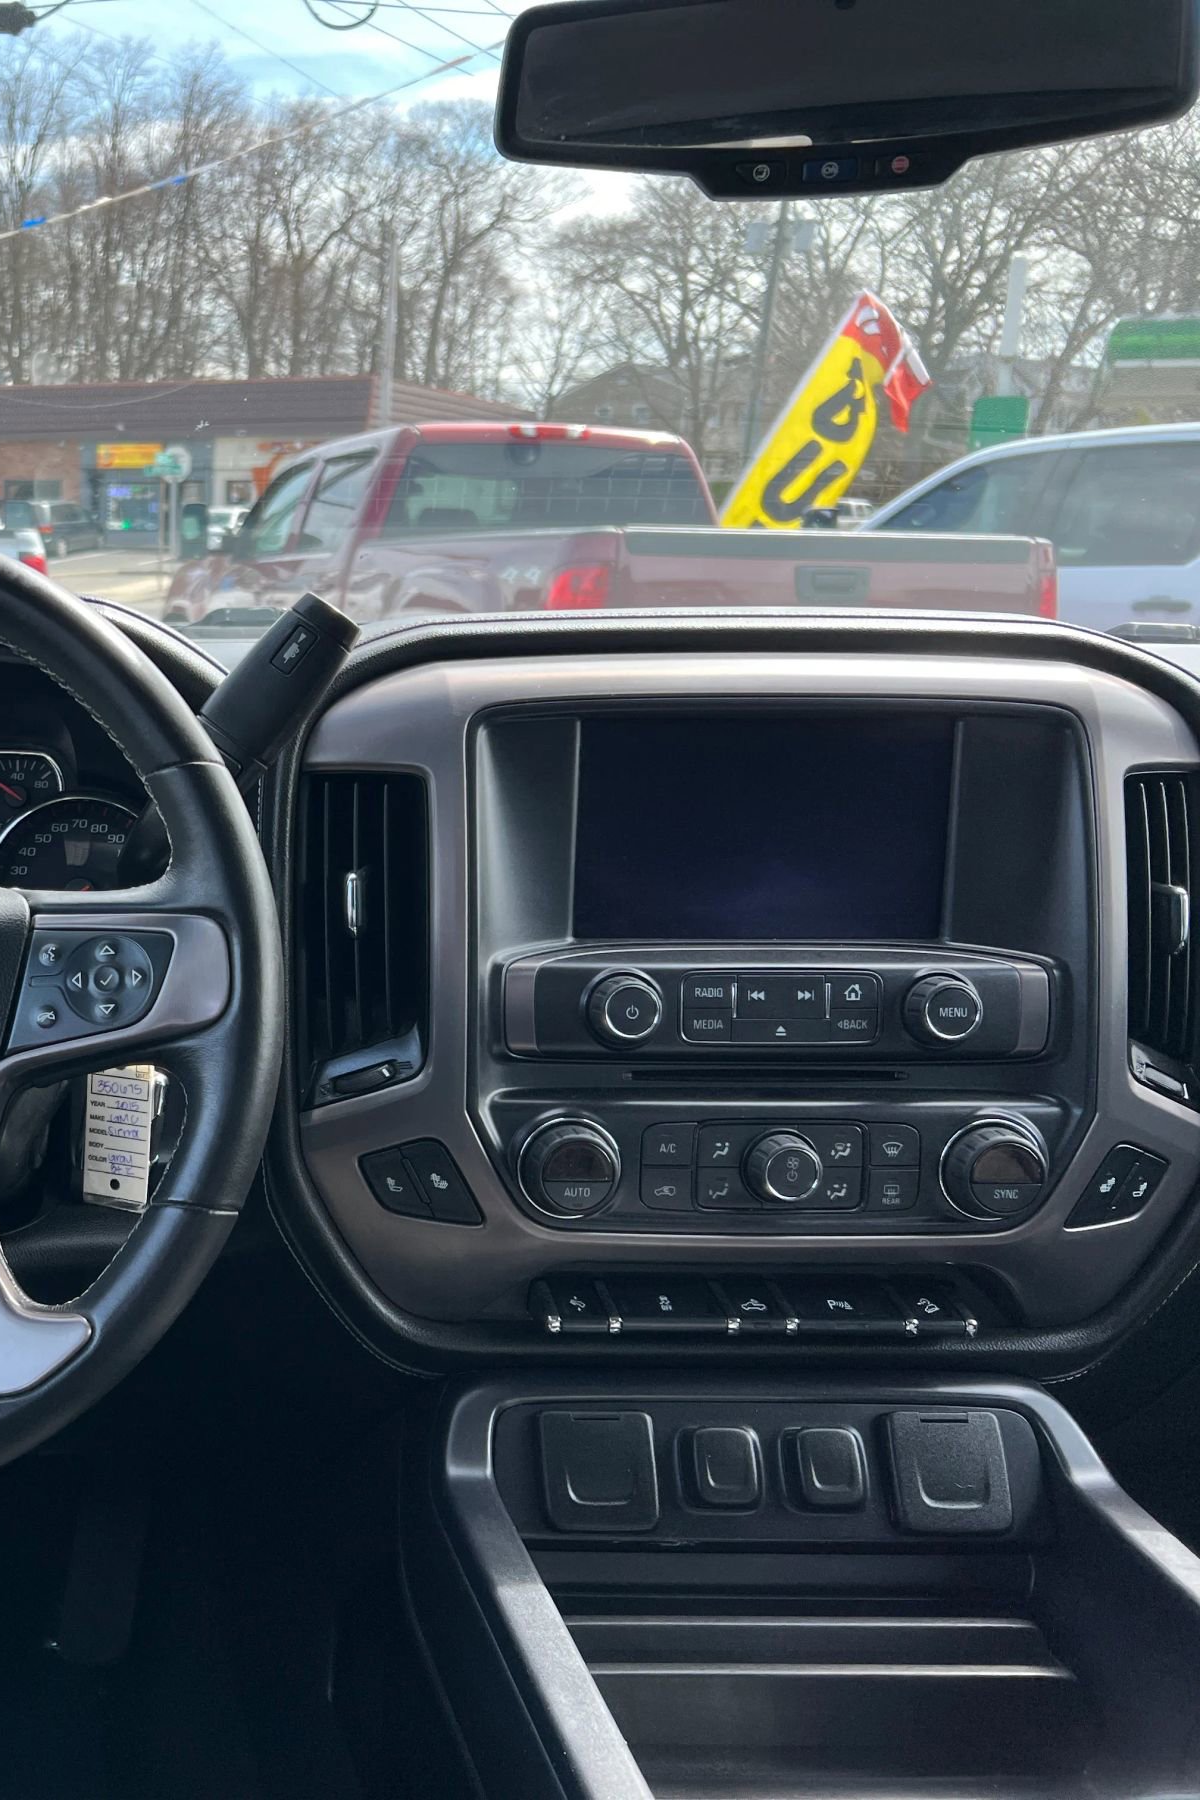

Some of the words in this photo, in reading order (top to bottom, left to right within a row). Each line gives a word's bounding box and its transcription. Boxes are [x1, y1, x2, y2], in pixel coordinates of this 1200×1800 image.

[10, 773, 25, 781] 40
[34, 781, 49, 789] 80
[51, 823, 69, 833] 60
[71, 818, 88, 829] 70
[90, 823, 109, 833] 80
[34, 833, 52, 843] 50
[107, 833, 125, 843] 90
[18, 847, 36, 856] 40
[10, 866, 28, 875] 30
[694, 987, 724, 998] RADIO
[939, 1007, 968, 1017] MENU
[693, 1019, 724, 1030] MEDIA
[843, 1019, 868, 1030] BACK
[90, 1100, 105, 1108] YEAR
[89, 1127, 108, 1136] MODEL
[659, 1143, 676, 1153] A/C
[88, 1154, 107, 1163] COLOR
[564, 1187, 591, 1198] AUTO
[993, 1189, 1019, 1199] SYNC
[882, 1197, 900, 1205] REAR
